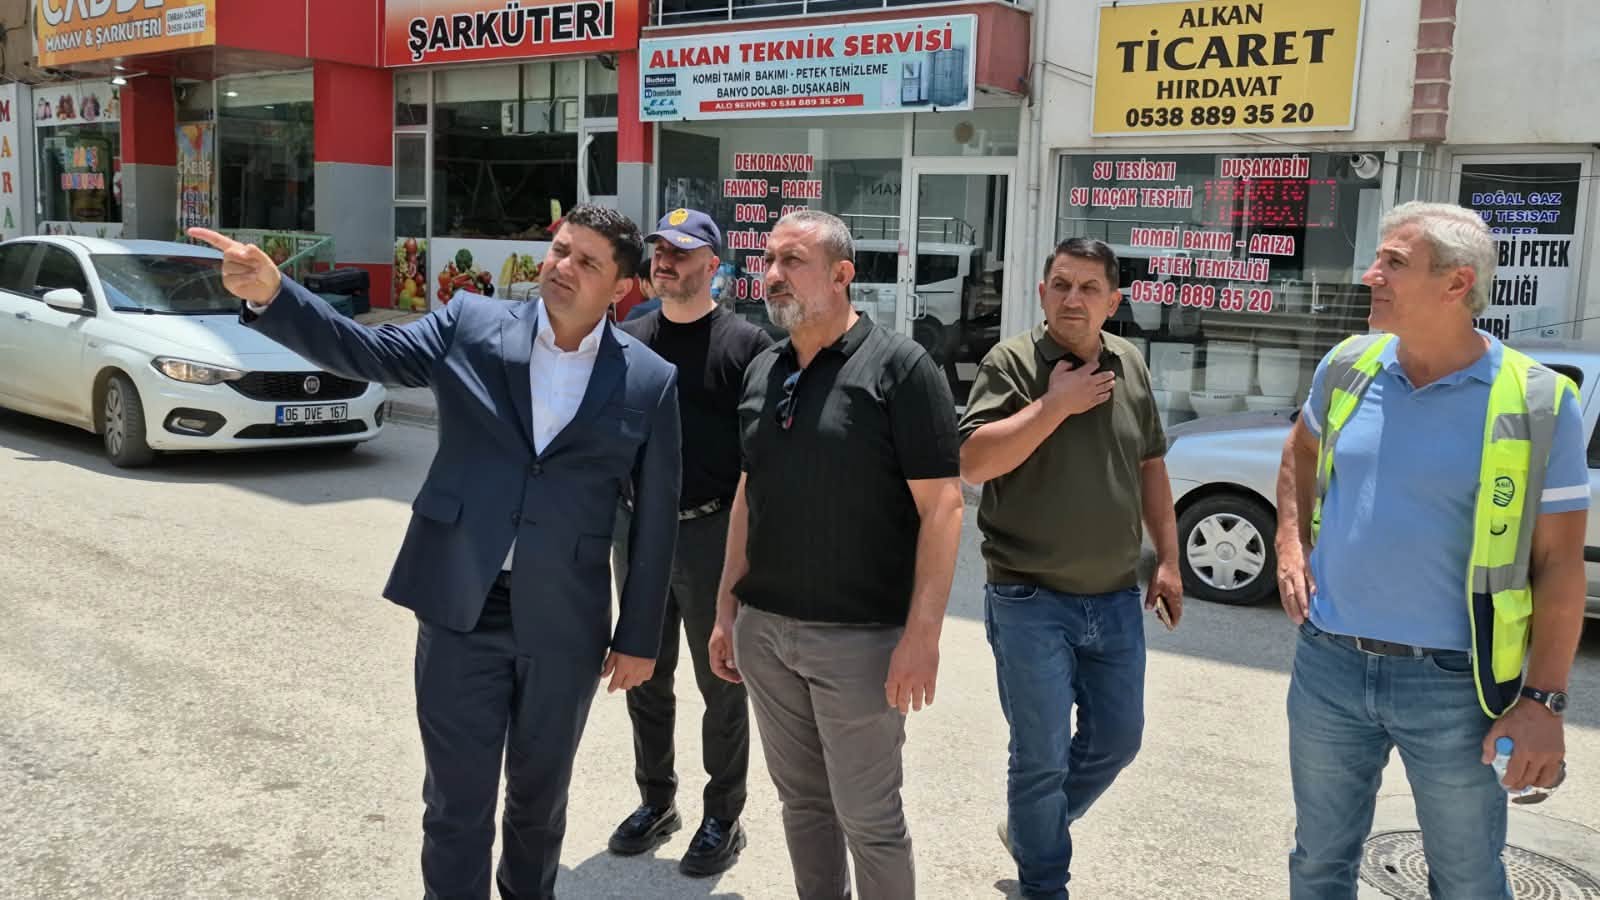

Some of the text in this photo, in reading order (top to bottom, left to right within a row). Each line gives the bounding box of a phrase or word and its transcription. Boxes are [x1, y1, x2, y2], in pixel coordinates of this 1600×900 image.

[1180, 3, 1263, 28] ALKAN
[46, 33, 82, 51] MANAV
[85, 29, 94, 47] &
[649, 22, 952, 68] ALKAN TEKNİK SERVİSİ
[1116, 29, 1334, 72] TİCARET
[692, 70, 722, 85] KOMBİ
[723, 68, 750, 83] TAMİR
[755, 68, 788, 81] BAKIMI
[796, 66, 826, 79] PETEK
[828, 62, 888, 77] TEMİZLEME
[716, 86, 748, 98] BANYO
[792, 79, 850, 96] DUŞAKABİN
[1156, 76, 1282, 100] HIRDAVAT
[715, 102, 732, 110] ALO
[779, 99, 796, 107] 538
[798, 98, 817, 106] 889
[833, 97, 846, 105] 20
[1126, 102, 1314, 128] 0538 889 35 20
[735, 153, 814, 171] DEKORASYON
[1093, 158, 1176, 181] SU TESİSATI
[1220, 154, 1309, 181] DUŞAKABİN
[782, 180, 822, 199] PARKE
[1071, 187, 1088, 205] SU
[1092, 188, 1137, 210] KAÇAK
[1141, 186, 1192, 208] TESPİTİ
[1472, 190, 1562, 205] DOĞAL GAZ
[736, 204, 766, 222] BOYA
[1477, 210, 1492, 221] U
[727, 228, 770, 250] TADİLA
[1130, 226, 1179, 248] KOMBİ
[1182, 230, 1232, 252] BAKIM
[1248, 234, 1294, 255] ARIZA
[1520, 240, 1570, 268] PETEK
[1148, 255, 1269, 282] PETEK TEMİZLİĞİ
[1132, 280, 1272, 312] 0538 889 35 20
[1488, 275, 1538, 306] İZLİĞİ
[286, 408, 298, 420] 06
[305, 407, 322, 420] DVE
[330, 406, 345, 418] 167
